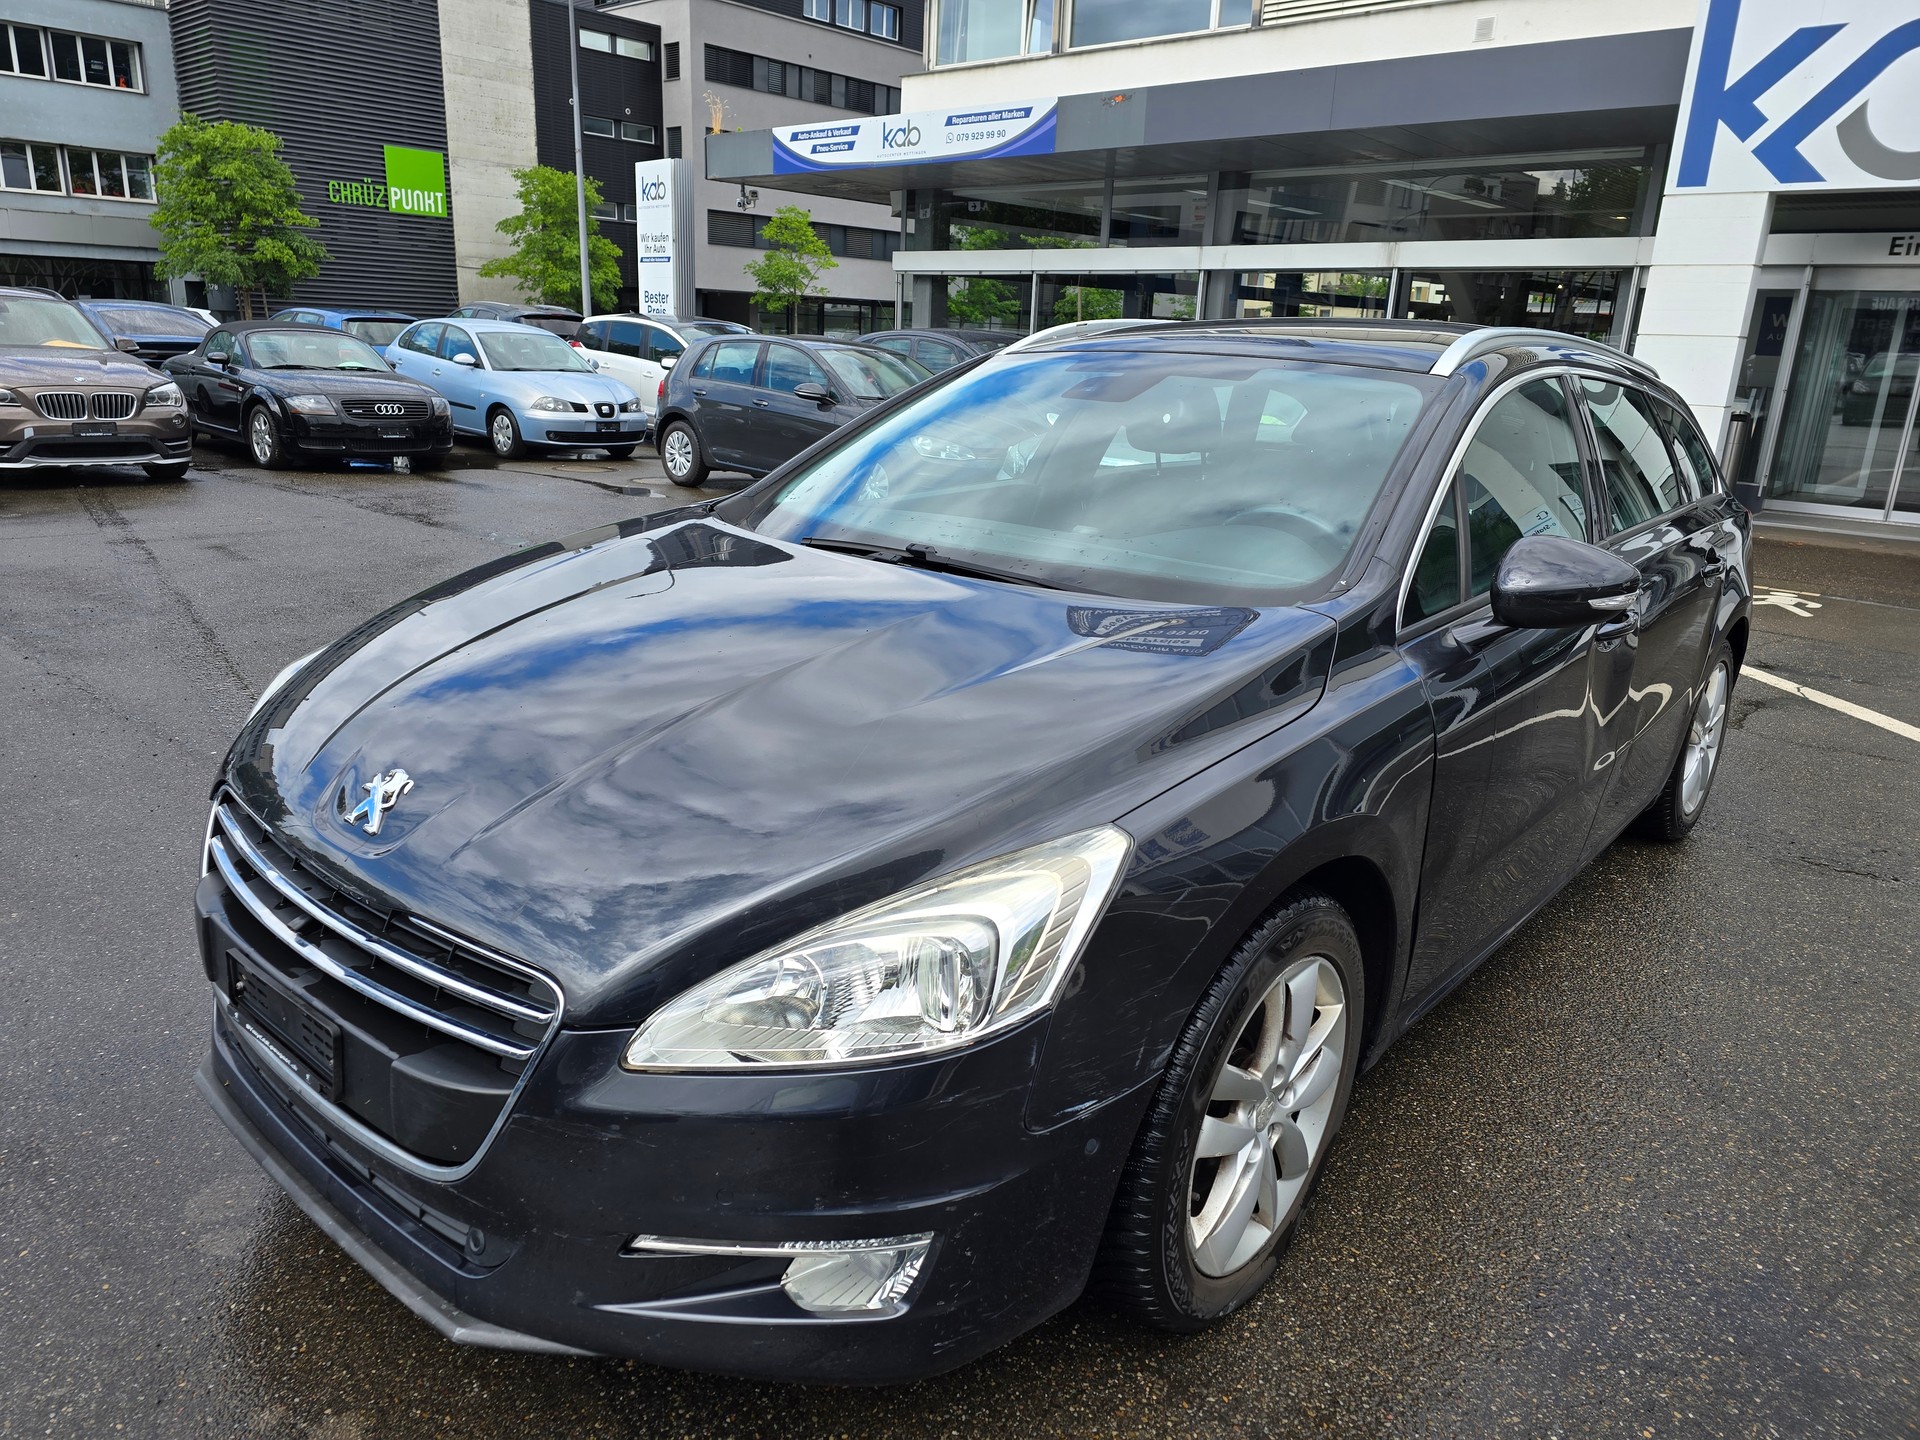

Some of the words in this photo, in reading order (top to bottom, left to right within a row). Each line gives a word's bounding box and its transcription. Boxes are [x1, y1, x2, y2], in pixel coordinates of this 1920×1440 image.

[951, 114, 987, 125] Reparaturen
[988, 112, 1001, 121] aller
[1002, 110, 1025, 119] Marken
[797, 130, 827, 140] Auto-Ankauf
[833, 127, 852, 137] Verkauf
[882, 119, 921, 149] kab
[956, 133, 969, 142] 079
[971, 131, 984, 140] 929
[985, 130, 995, 139] 99
[996, 129, 1006, 138] 90
[816, 143, 848, 153] Pneu-Service
[641, 174, 666, 201] kab
[328, 177, 386, 207] CHRÜZ
[390, 187, 443, 214] PUNKT
[640, 234, 650, 243] Wir
[650, 232, 669, 243] kaufen
[644, 244, 652, 254] Ihr
[653, 243, 666, 254] Auto
[644, 290, 669, 305] Bester
